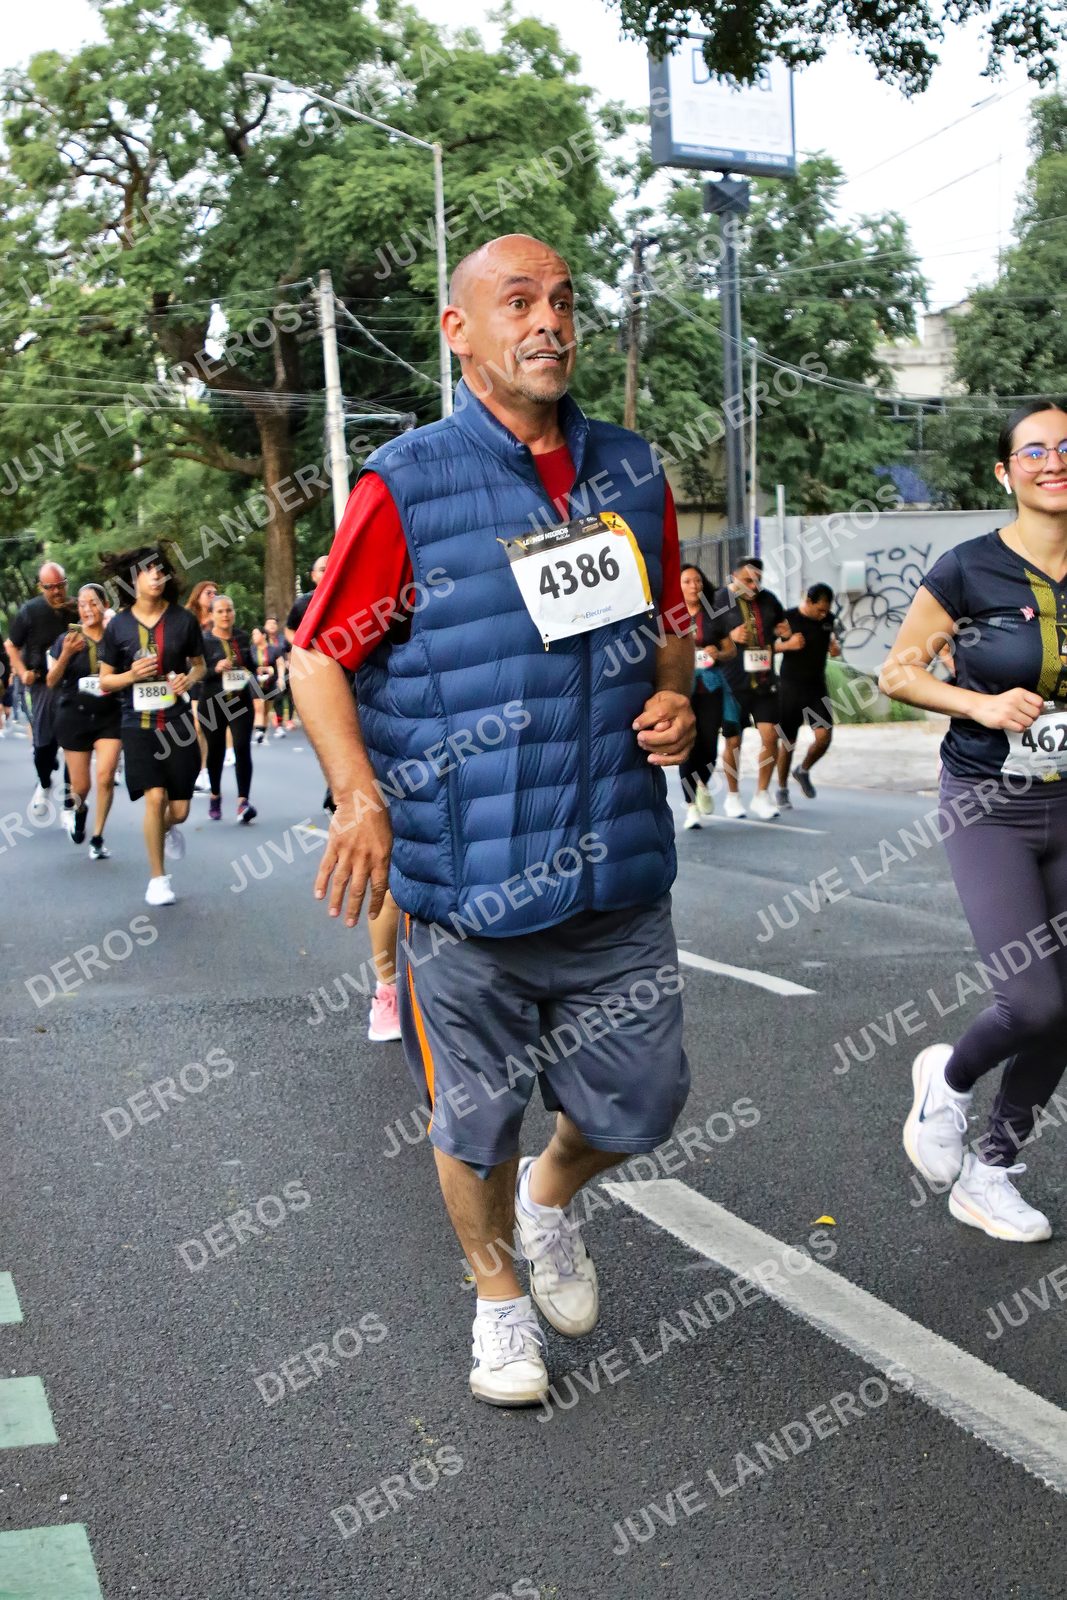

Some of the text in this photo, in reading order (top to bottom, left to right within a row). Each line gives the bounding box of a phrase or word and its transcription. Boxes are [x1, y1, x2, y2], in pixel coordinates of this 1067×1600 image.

[867, 543, 932, 569] TOY
[539, 545, 620, 600] 4386
[138, 686, 167, 698] 3880
[1022, 724, 1067, 752] 462
